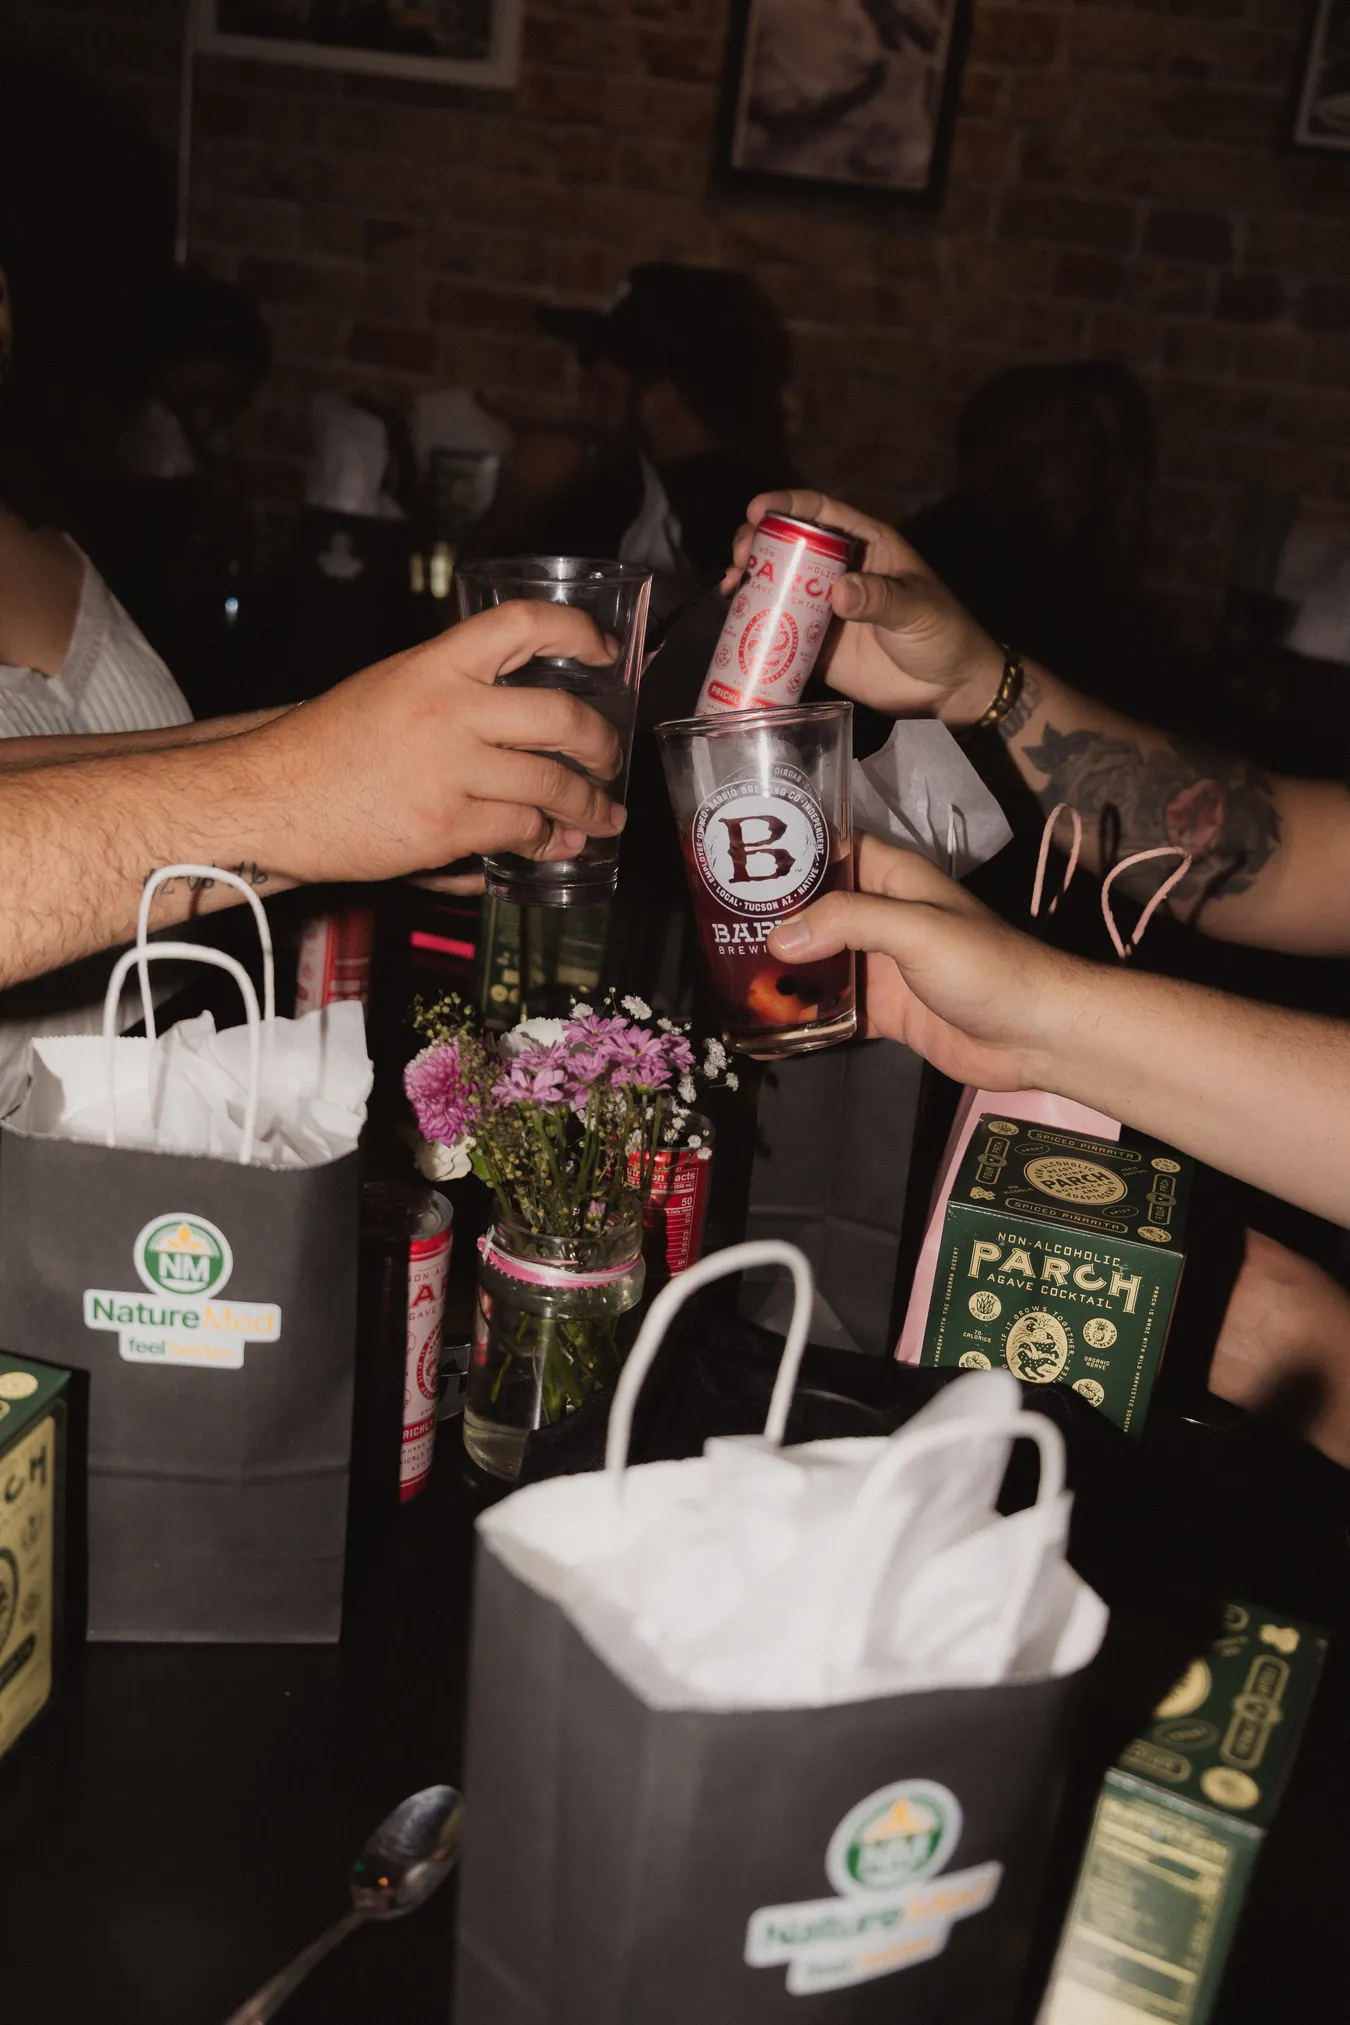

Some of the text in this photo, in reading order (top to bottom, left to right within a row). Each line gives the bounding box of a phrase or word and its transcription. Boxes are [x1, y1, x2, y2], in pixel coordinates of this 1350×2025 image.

[708, 785, 801, 810] BARRIO BREING CO
[801, 801, 825, 855] INDEPENDENT
[718, 815, 796, 883] B
[797, 867, 819, 895] NATIVE
[716, 885, 739, 907] LOCAL
[744, 895, 794, 911] TUCSON AZ
[712, 920, 783, 943] BAR
[719, 945, 766, 955] BREWI
[1036, 1133, 1075, 1146] SPICED
[673, 1172, 696, 1182] acts
[1040, 1171, 1111, 1189] PARCH
[1055, 1181, 1115, 1193] BOTANICALS
[681, 1197, 693, 1206] 50
[1014, 1201, 1057, 1216] SPICED
[951, 1247, 959, 1270] DESERT
[997, 1231, 1121, 1267] NON-ALCOHOLIC
[159, 1253, 210, 1282] NM
[967, 1239, 1143, 1315] PARCH
[987, 1273, 1113, 1309] AGAVE COCKTAIL
[1151, 1286, 1160, 1306] PARCH
[93, 1297, 274, 1334] NatureMed
[1014, 1306, 1047, 1320] GROWS
[1144, 1317, 1153, 1334] MADE
[962, 1332, 992, 1343] CALORIES
[1140, 1337, 1148, 1352] WITH
[129, 1338, 231, 1360] feel better
[1083, 1356, 1110, 1366] ORGANIC
[1136, 1355, 1145, 1369] WILD
[1128, 1372, 1141, 1407] HARVESTED
